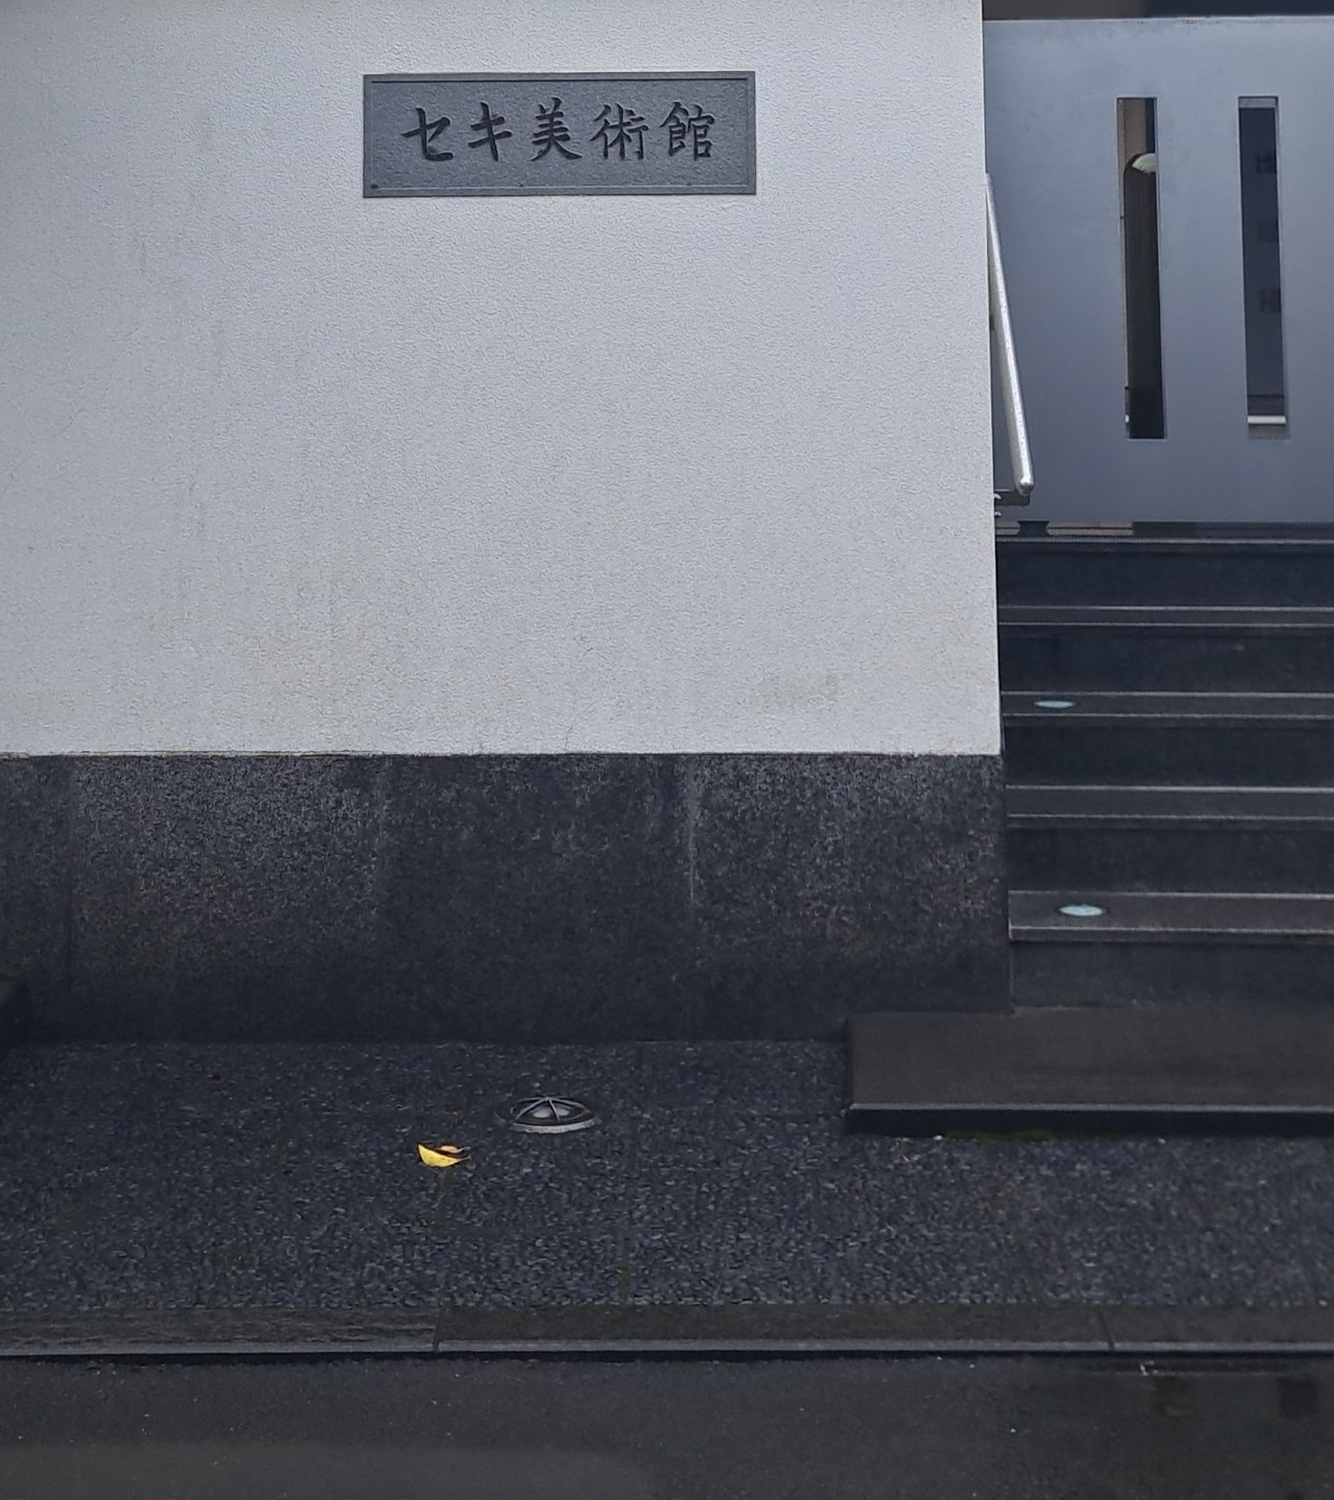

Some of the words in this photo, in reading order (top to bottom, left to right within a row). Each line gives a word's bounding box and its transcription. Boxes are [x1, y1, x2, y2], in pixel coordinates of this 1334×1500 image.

[401, 97, 717, 162] セキ美術館
